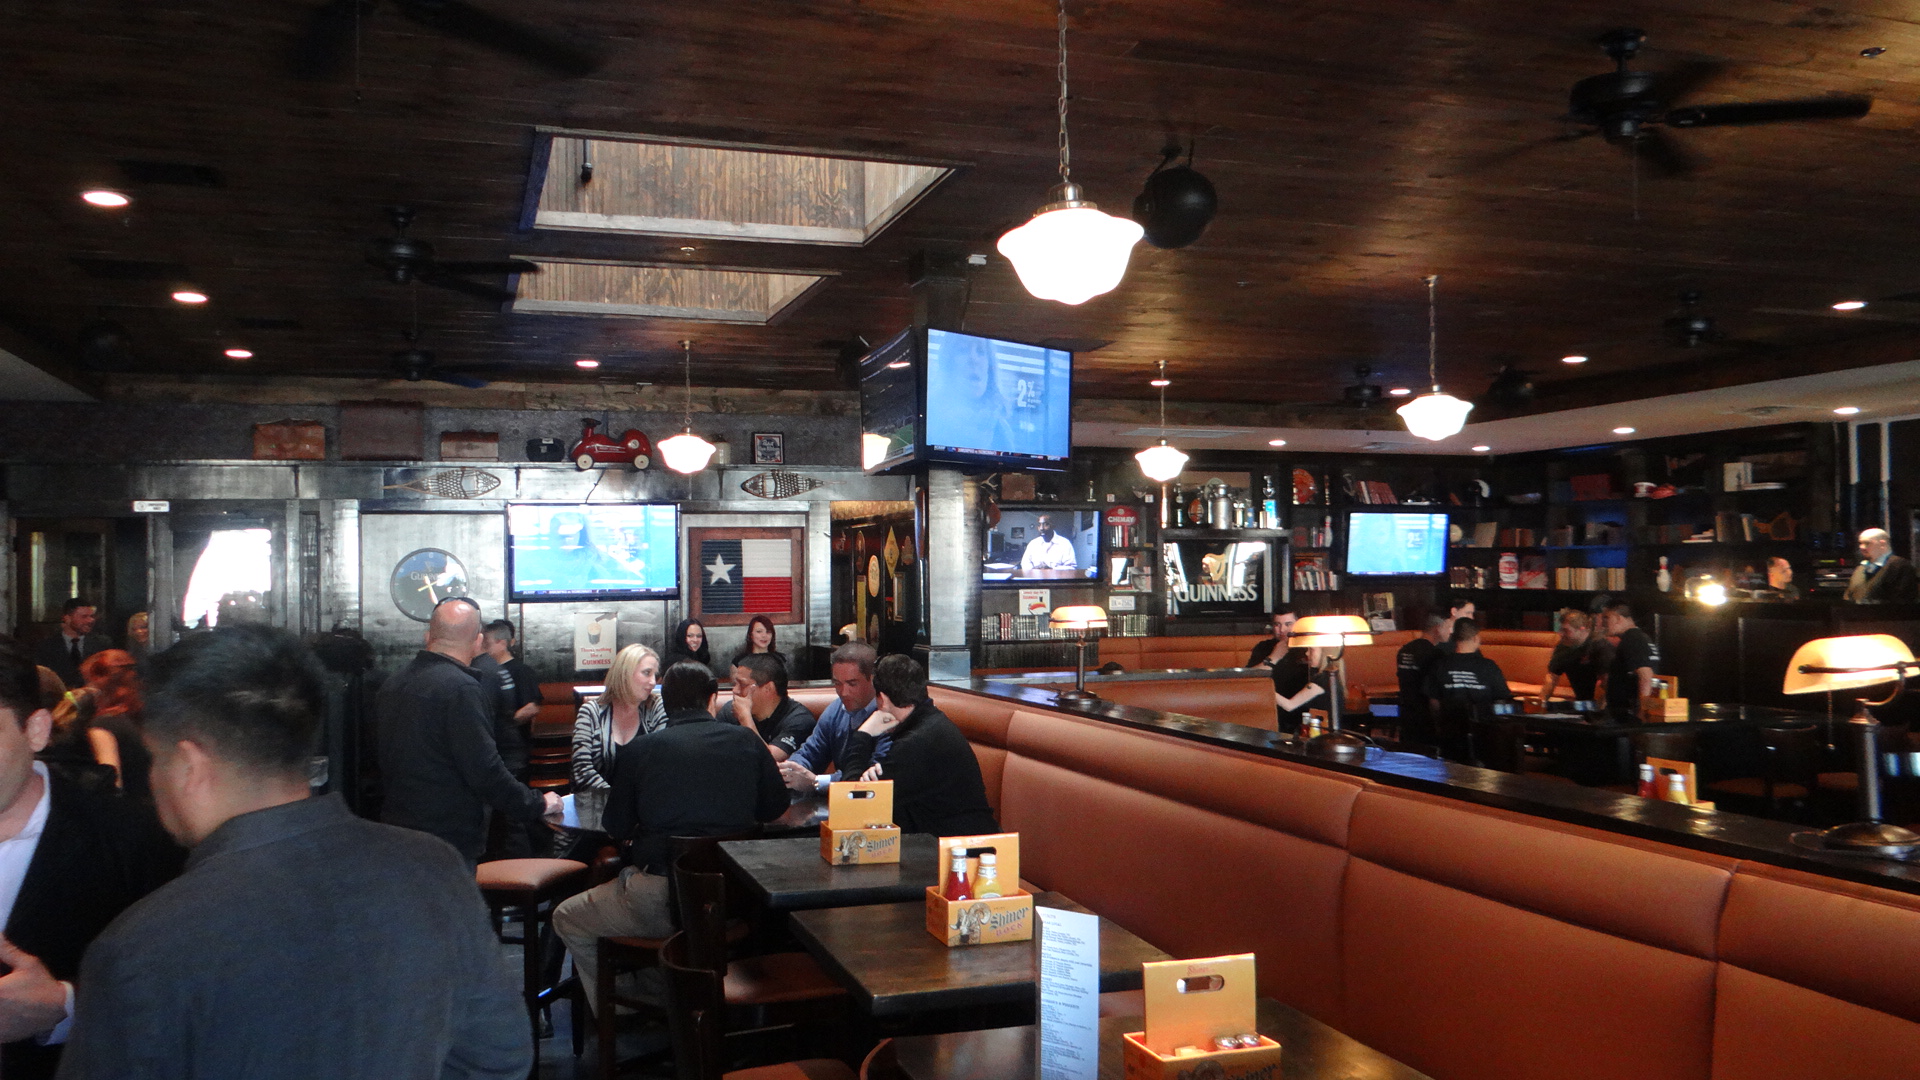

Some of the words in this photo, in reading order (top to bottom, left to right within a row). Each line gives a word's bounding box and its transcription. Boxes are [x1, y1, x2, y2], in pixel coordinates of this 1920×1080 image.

[1175, 584, 1258, 602] GUINNESS
[989, 906, 1029, 930] Shiner
[996, 922, 1022, 936] BOCK
